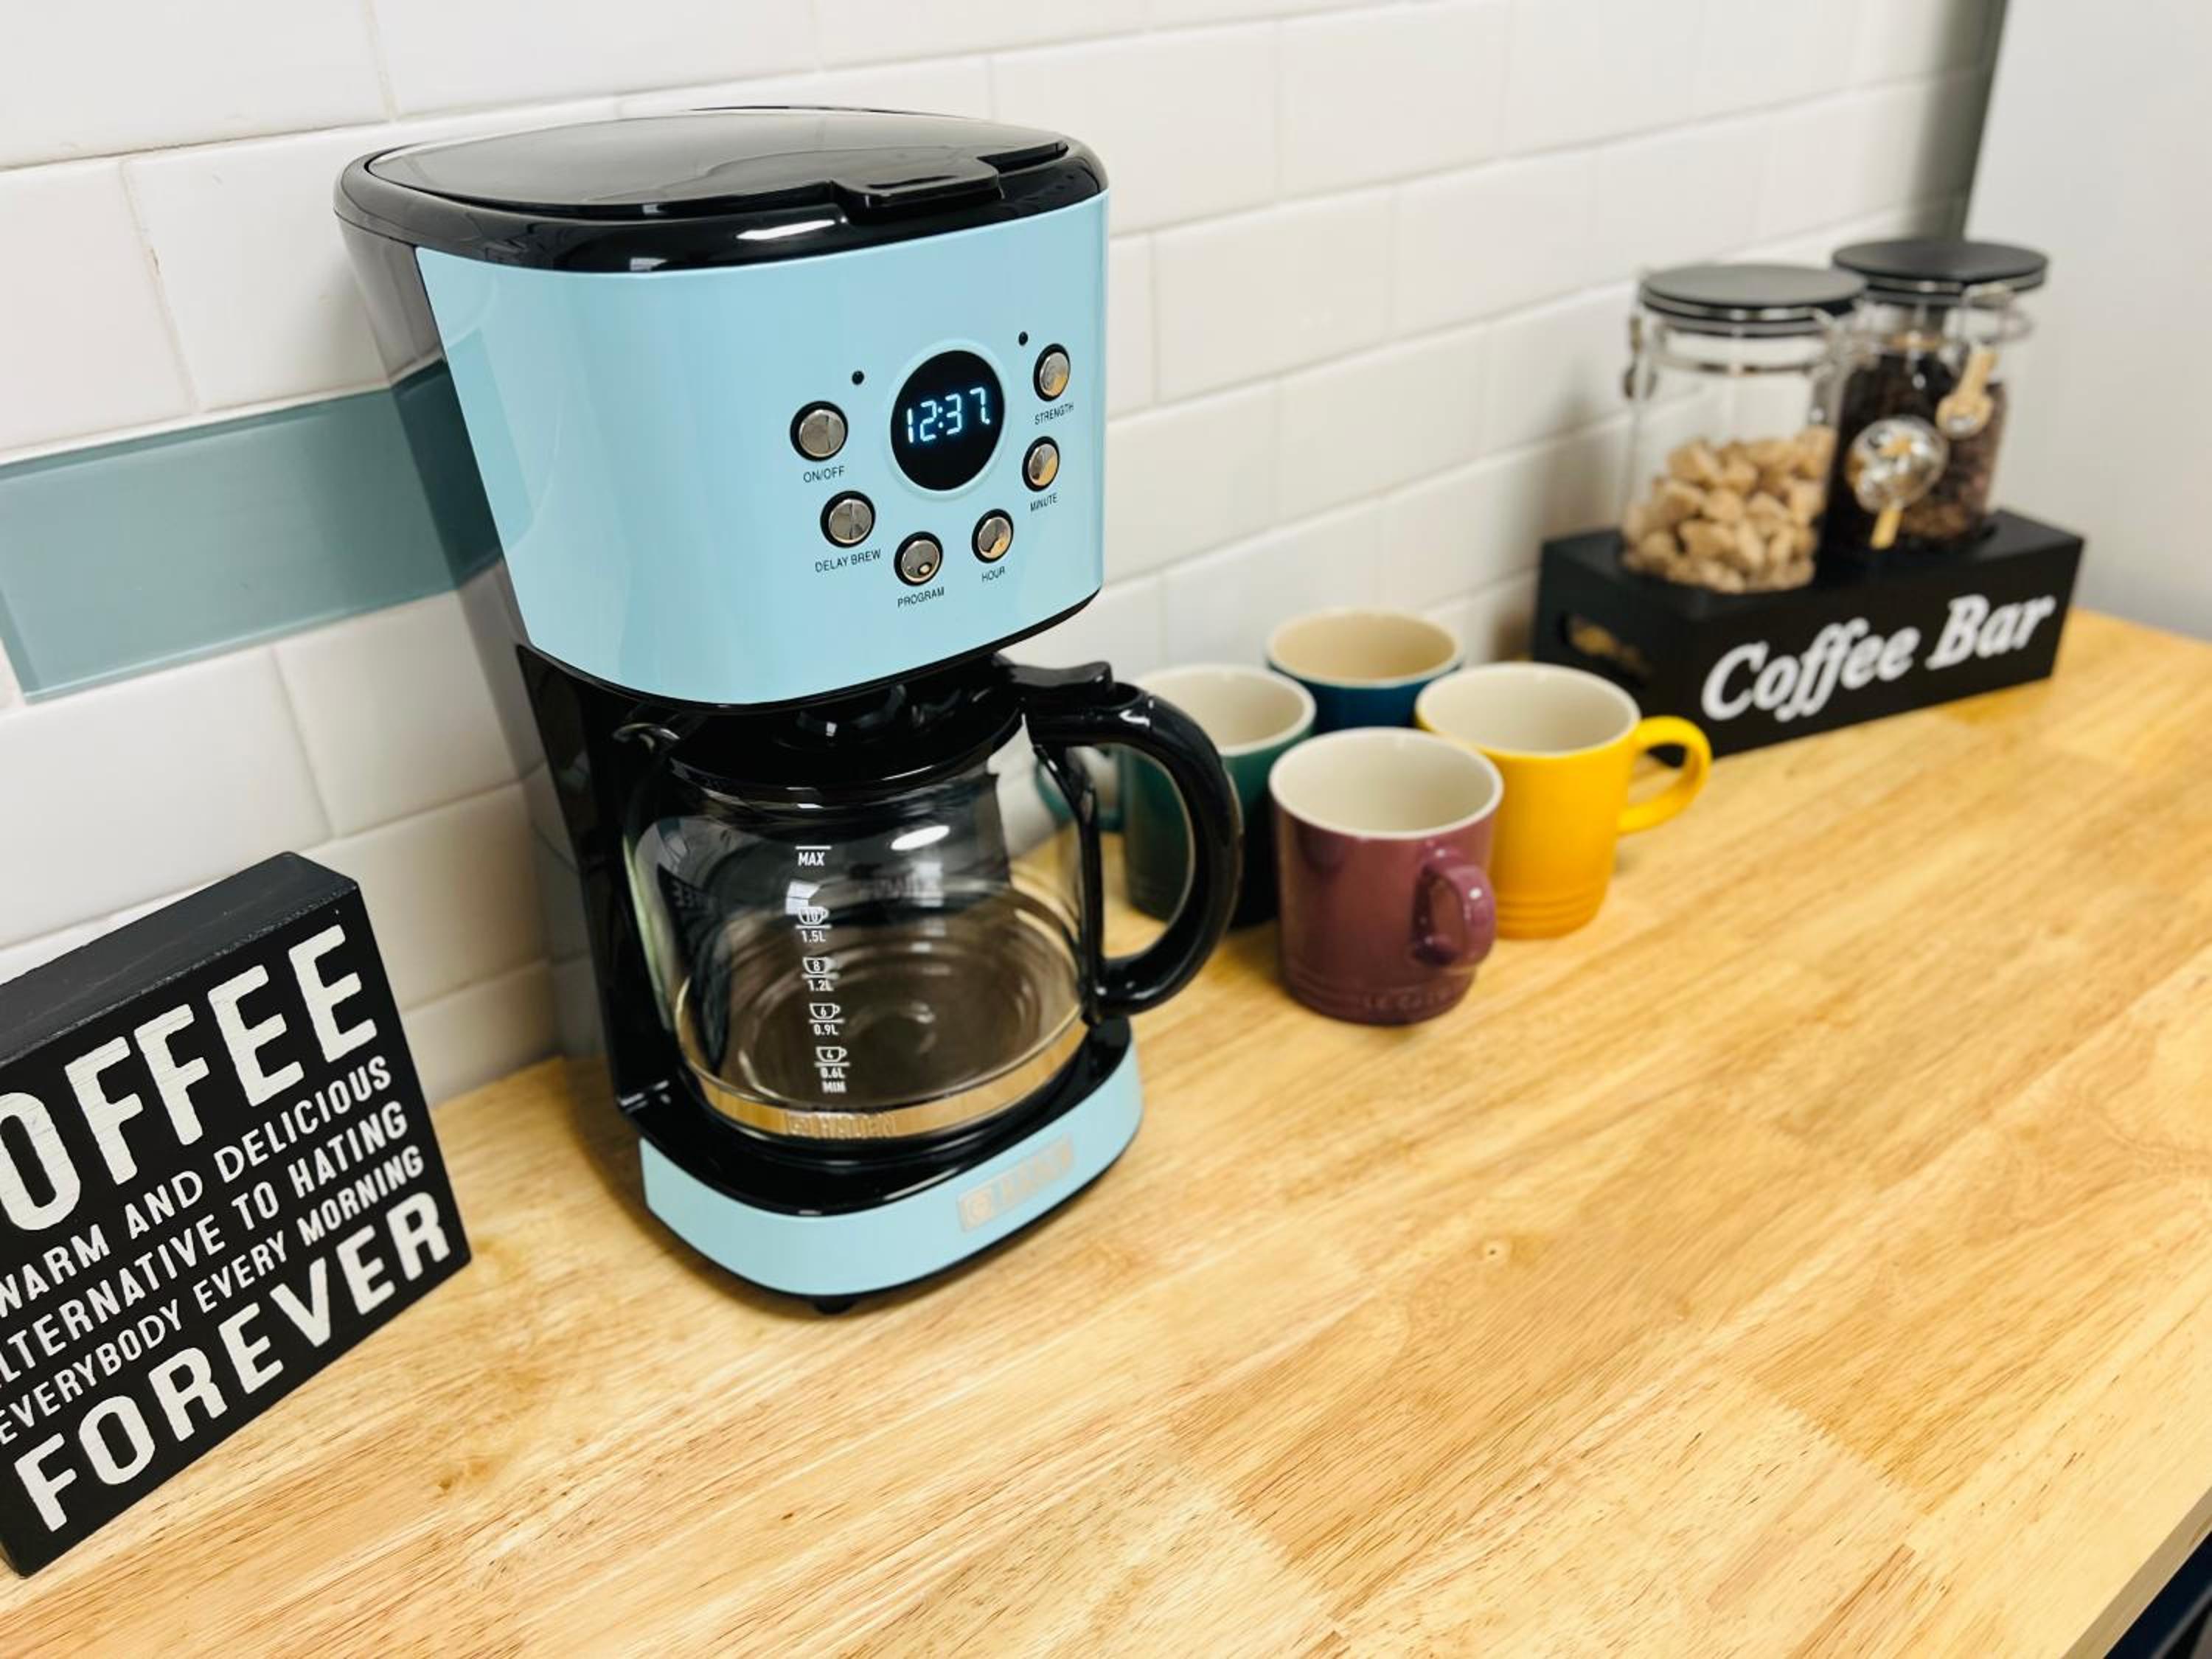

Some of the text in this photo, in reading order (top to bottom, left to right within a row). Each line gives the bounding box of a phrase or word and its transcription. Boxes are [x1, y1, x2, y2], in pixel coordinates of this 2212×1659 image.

[1034, 402, 1074, 425] STRENGTH
[803, 465, 845, 484] ON/OFF
[1029, 493, 1058, 512] MINUTE
[815, 549, 881, 574] DELAY BREW
[981, 566, 1006, 582] HOUR
[897, 586, 945, 608] PROGRAM
[1702, 594, 2056, 722] Coffee Bar
[798, 852, 825, 866] MAX
[801, 929, 827, 943] 1.5L
[813, 961, 821, 972] 8
[807, 979, 834, 992] 1.2L
[819, 1006, 827, 1018] 6
[813, 1023, 839, 1035] 0.9L
[0, 923, 378, 1231] OFFEE
[819, 1066, 846, 1079] 0.6L
[821, 1080, 846, 1094] MIN
[125, 1169, 204, 1240] AND
[212, 1055, 392, 1184] DELICIOUS
[0, 1100, 408, 1391] LTERNATIVE TO HATING
[0, 1144, 424, 1445] EVERYBODY EVERY MORNING
[13, 1192, 451, 1533] FOREVER
